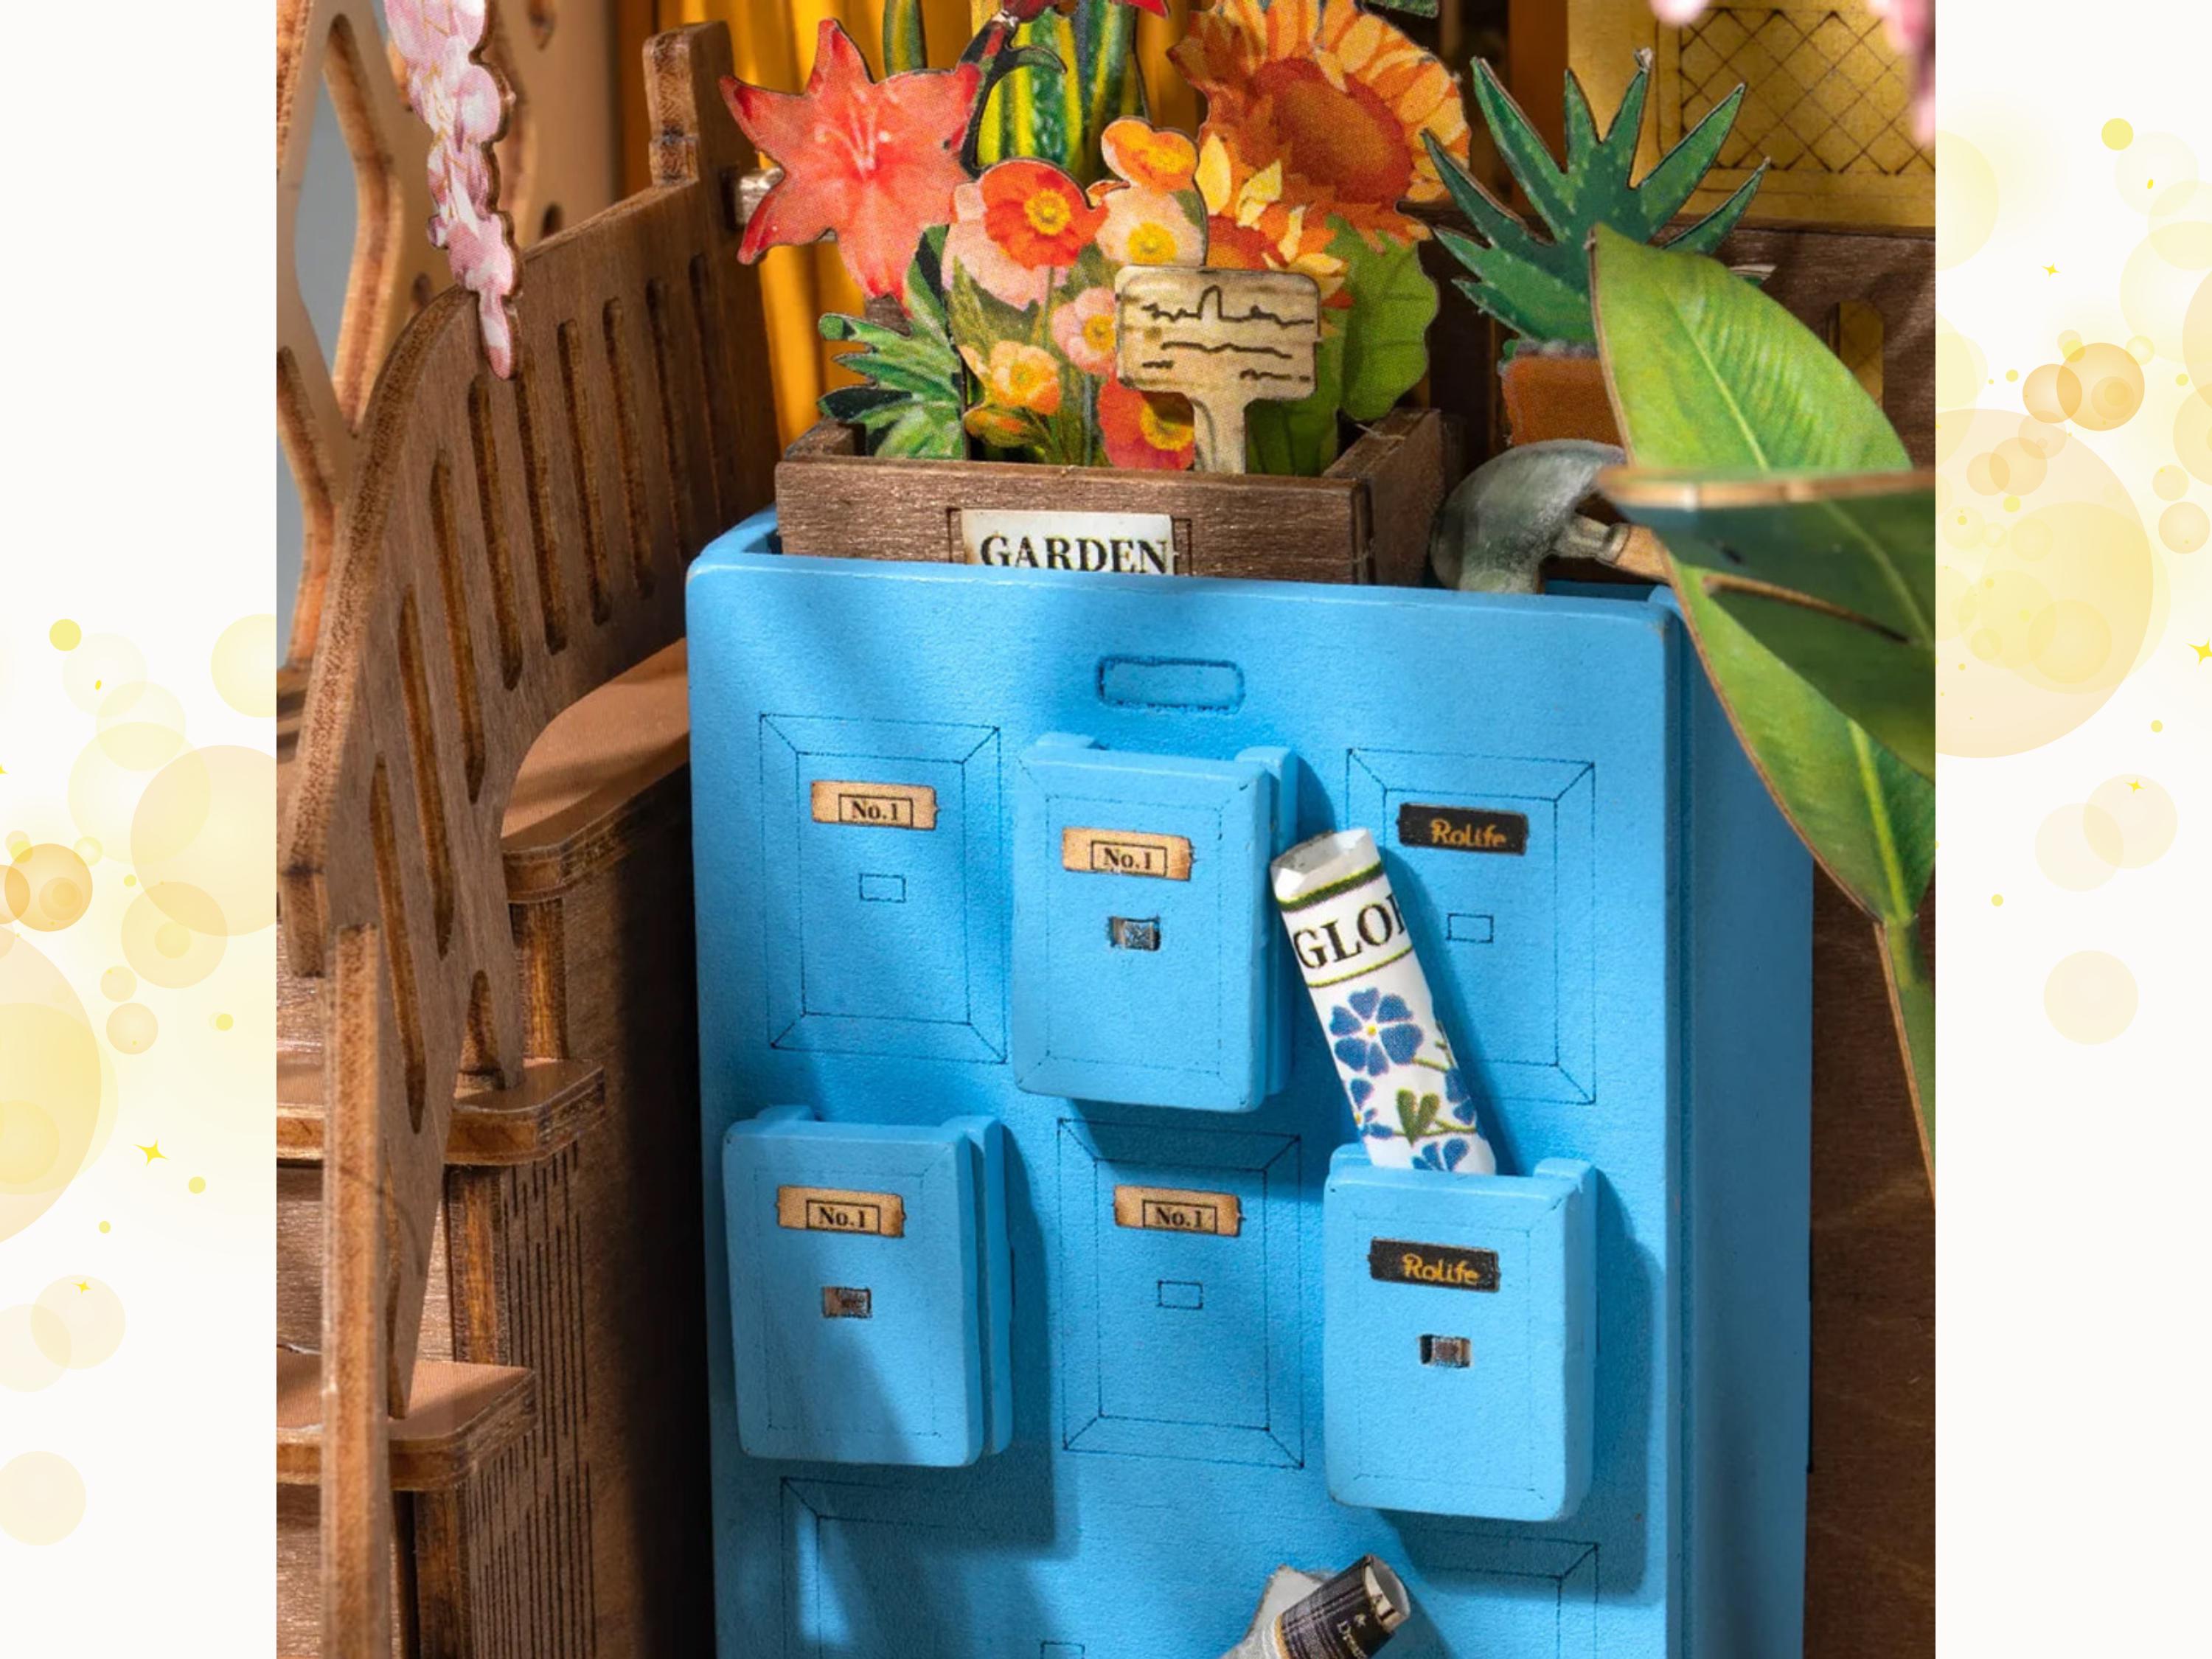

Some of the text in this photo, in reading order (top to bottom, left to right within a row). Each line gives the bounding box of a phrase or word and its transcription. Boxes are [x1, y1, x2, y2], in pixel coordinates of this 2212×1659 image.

[980, 532, 1168, 574] GARDEN
[1429, 818, 1506, 847] Rolife
[1403, 1253, 1481, 1286] Rolife
